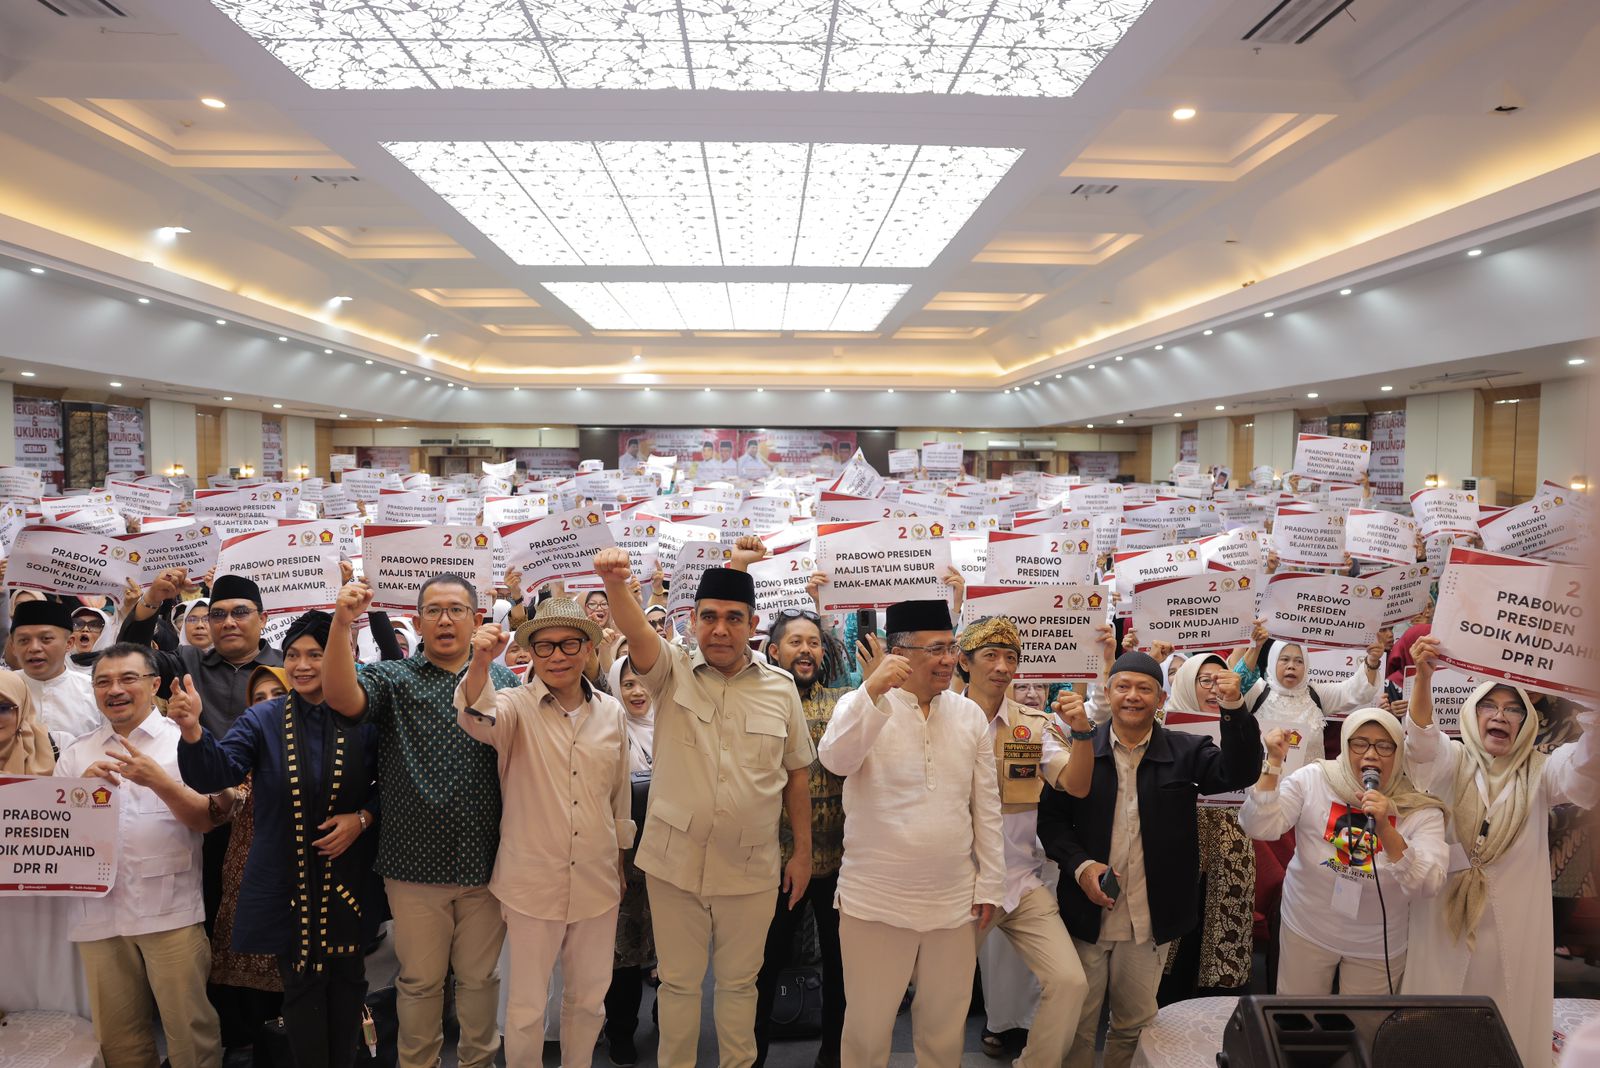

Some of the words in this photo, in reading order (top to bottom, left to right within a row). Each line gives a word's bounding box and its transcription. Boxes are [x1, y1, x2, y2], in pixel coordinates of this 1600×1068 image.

[14, 403, 58, 416] EKLARASI
[15, 427, 59, 438] UKUNGAN
[1305, 449, 1333, 457] PRABOWO
[1335, 452, 1362, 460] PRESIDEN
[1307, 462, 1335, 470] BANDUNG
[883, 509, 891, 518] 2
[1532, 504, 1540, 514] 2
[722, 519, 728, 527] 2
[1328, 517, 1332, 525] 2
[1436, 513, 1472, 522] MUDJAHID
[1506, 514, 1546, 532] PRABOWO
[560, 520, 570, 531] 2
[1063, 521, 1068, 529] 2
[1284, 525, 1319, 534] PRABOWO
[1367, 523, 1400, 533] PRABOWO
[623, 527, 631, 536] 2
[898, 527, 907, 539] 2
[1367, 531, 1397, 541] PRESIDEN
[1511, 522, 1547, 540] PRESIDEN
[175, 534, 184, 542] 2
[287, 533, 297, 547] 2
[443, 535, 452, 547] 2
[529, 533, 578, 550] PRABOWO
[1500, 541, 1523, 552] SODIK
[1524, 524, 1565, 545] MUDJAHID
[98, 544, 108, 555] 2
[170, 540, 208, 554] PRESIDEN
[1051, 541, 1058, 552] 2
[1218, 543, 1248, 552] PRABOWO
[1289, 541, 1327, 550] SEJAHTERA
[1373, 539, 1408, 550] MUDJAHID
[1522, 543, 1537, 551] DPR
[1539, 539, 1547, 547] RI
[51, 547, 108, 567] PRABOWO
[168, 551, 199, 561] DIFABEL
[696, 548, 705, 559] 2
[836, 552, 885, 561] PRABOWO
[887, 549, 932, 558] PRESIDEN
[1166, 553, 1174, 562] 2
[1222, 552, 1250, 560] PRESIDEN
[188, 556, 205, 566] DAN
[230, 559, 275, 572] PRABOWO
[276, 555, 321, 566] PRESIDEN
[381, 555, 428, 565] PRABOWO
[430, 557, 475, 566] PRESIDEN
[522, 556, 552, 571] SODIK
[552, 562, 571, 570] DPR
[572, 560, 582, 568] RI
[790, 560, 799, 571] 2
[1015, 556, 1062, 566] PRABOWO
[51, 558, 101, 577] PRESIDEN
[834, 565, 869, 575] MAJLIS
[871, 565, 901, 573] TA'LIM
[903, 563, 935, 571] SUBUR
[1017, 568, 1060, 577] PRESIDEN
[1139, 565, 1178, 576] PRABOWO
[26, 562, 61, 576] SODIK
[61, 570, 119, 588] MUDJAHID
[261, 571, 290, 580] TA'LIM
[292, 568, 324, 577] SUBUR
[379, 569, 413, 578] MAJLIS
[1400, 572, 1406, 581] 2
[53, 578, 74, 589] DPR
[77, 583, 87, 591] RI
[282, 581, 326, 592] MAKMUR
[833, 580, 891, 588] EMAK-EMAK
[893, 576, 937, 585] MAKMUR
[1208, 581, 1217, 592] 2
[1391, 580, 1422, 592] PRESIDEN
[1340, 584, 1349, 595] 2
[1565, 580, 1581, 598] 2
[1053, 595, 1063, 608] 2
[1166, 595, 1221, 606] PRABOWO
[1296, 592, 1351, 606] PRABOWO
[1400, 598, 1414, 606] DAN
[1497, 590, 1583, 618] PRABOWO
[1169, 607, 1219, 617] PRESIDEN
[1297, 603, 1346, 617] PRESIDEN
[1040, 616, 1090, 625] PRESIDEN
[1149, 621, 1181, 630] SODIK
[1183, 617, 1239, 628] MUDJAHID
[1275, 611, 1307, 623] SODIK
[1309, 617, 1365, 630] MUDJAHID
[1496, 609, 1575, 636] PRESIDEN
[1031, 630, 1074, 638] DIFABEL
[1178, 631, 1198, 640] DPR
[1201, 630, 1210, 638] RI
[1301, 626, 1322, 635] DPR
[1324, 628, 1335, 637] RI
[1459, 620, 1511, 642] SODIK
[1054, 642, 1077, 650] DAN
[1346, 656, 1353, 666] 2
[1501, 648, 1534, 667] DPR
[1537, 657, 1553, 671] RI
[56, 788, 66, 804] 2
[3, 809, 72, 822] PRABOWO
[5, 827, 70, 839] PRESIDEN
[22, 845, 95, 857] MUDJAHID
[13, 862, 41, 874] DPR
[45, 862, 58, 874] RI
